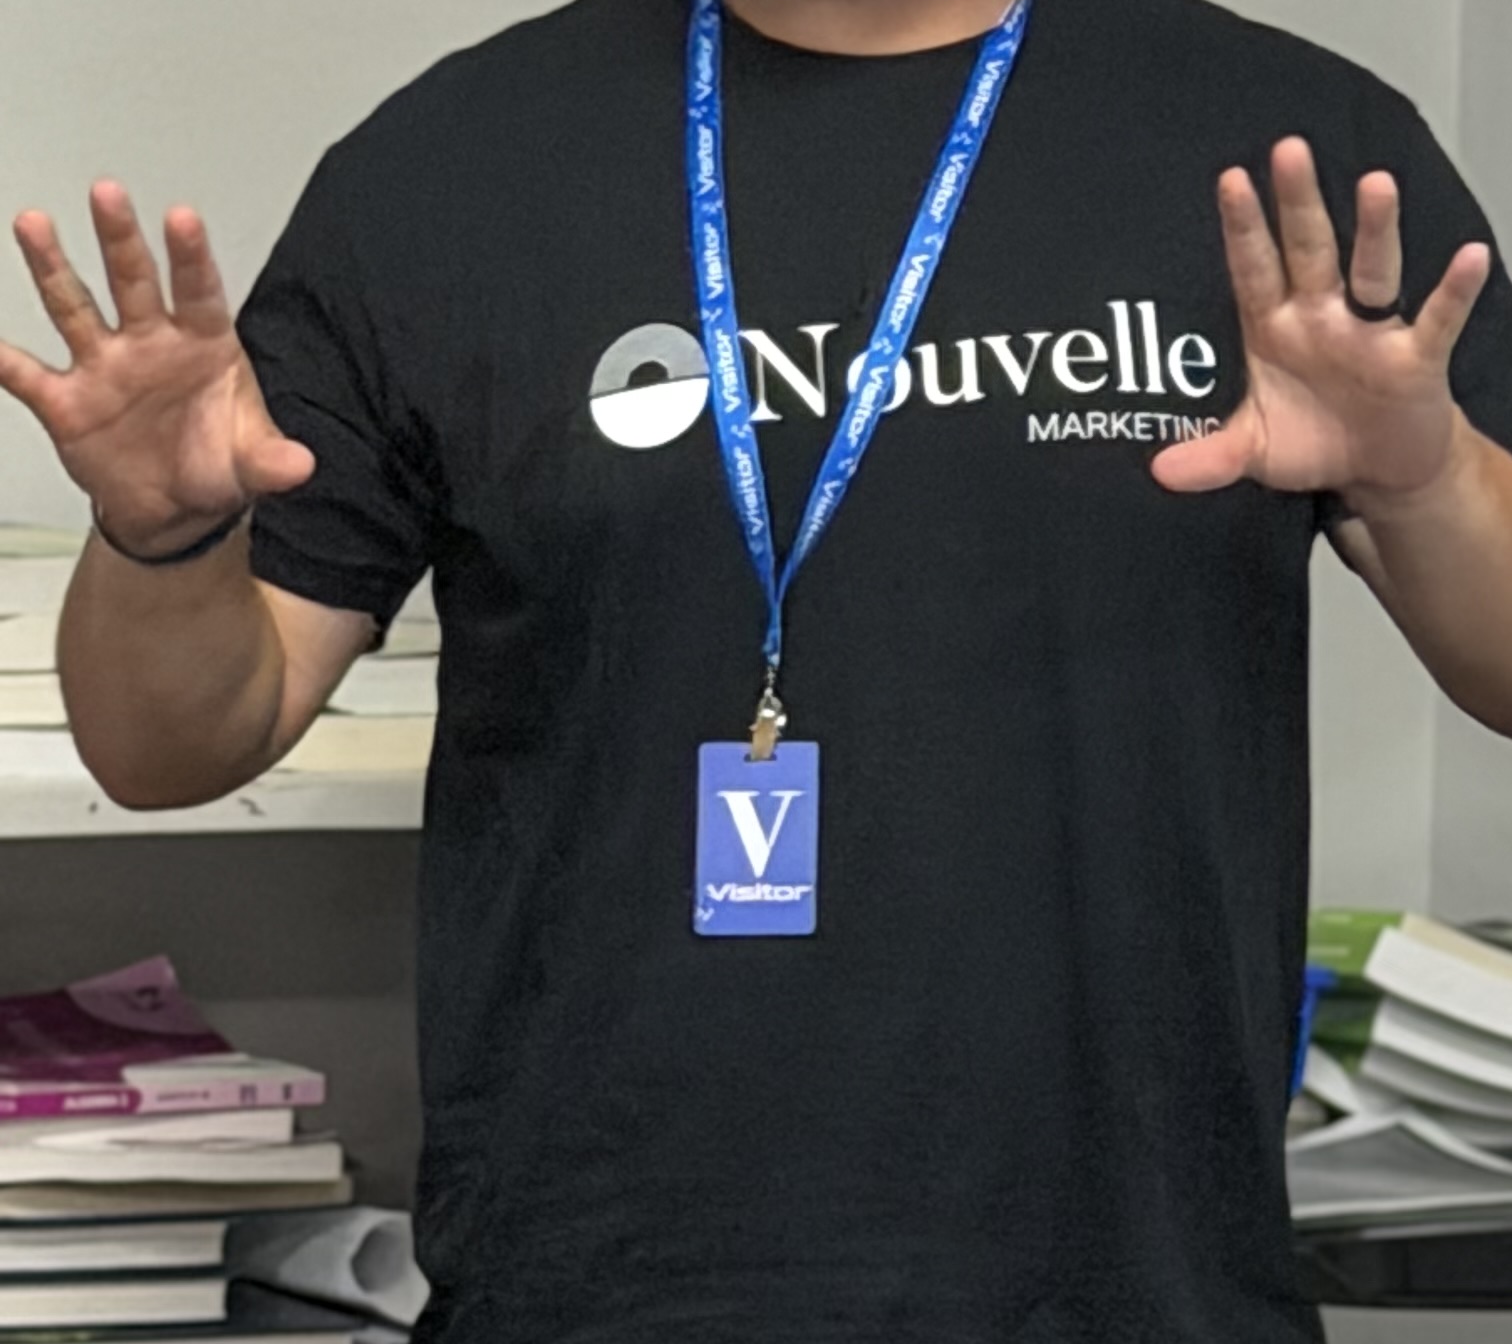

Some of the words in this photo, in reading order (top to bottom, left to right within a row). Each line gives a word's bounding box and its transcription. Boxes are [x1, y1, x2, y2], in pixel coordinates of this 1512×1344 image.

[703, 222, 725, 300] Visitor
[889, 253, 931, 335] Visitor
[714, 328, 742, 414] Visitor
[737, 299, 1217, 422] Nouvelle
[847, 365, 890, 449] Visitor
[734, 446, 765, 536] Visitor
[715, 789, 808, 879] V
[706, 883, 813, 902] Visitor
